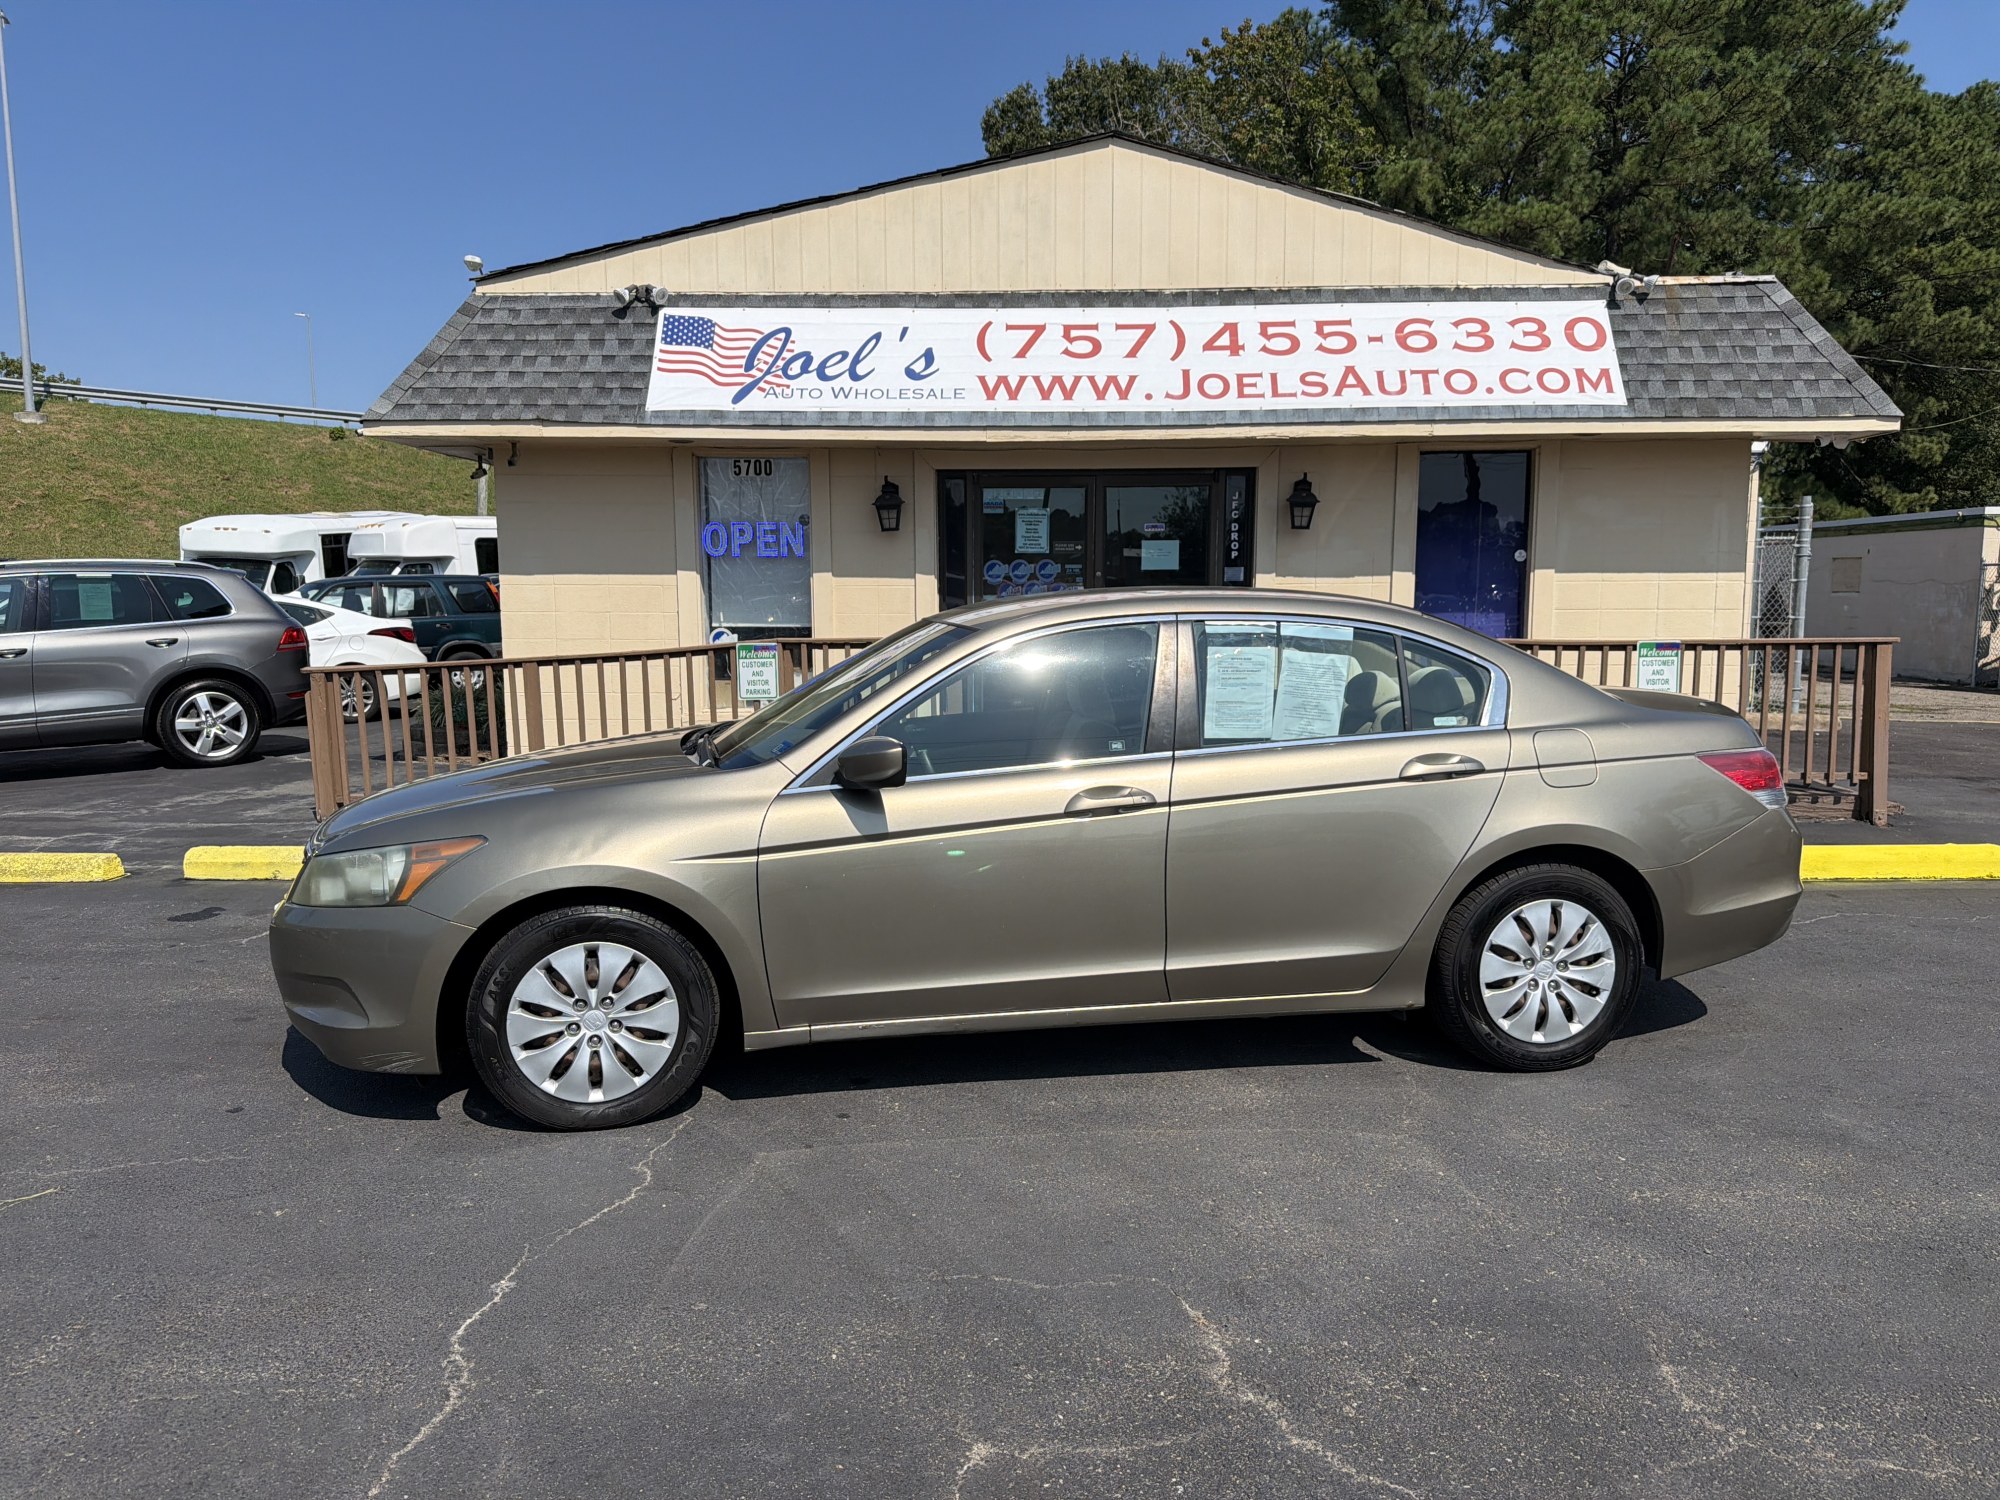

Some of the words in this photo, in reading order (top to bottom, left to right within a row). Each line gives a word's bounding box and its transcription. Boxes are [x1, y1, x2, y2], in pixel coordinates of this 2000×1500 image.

[976, 317, 1608, 362] (757)455-6330
[731, 326, 940, 405] Joel's
[764, 386, 822, 400] AUTO
[830, 386, 966, 400] WHOLESALE
[733, 459, 773, 477] 5700
[702, 521, 805, 559] OPEN
[1230, 523, 1240, 560] DROP
[739, 650, 775, 658] Welcome
[1640, 648, 1678, 657] Welcome
[1645, 678, 1670, 686] VISITOR
